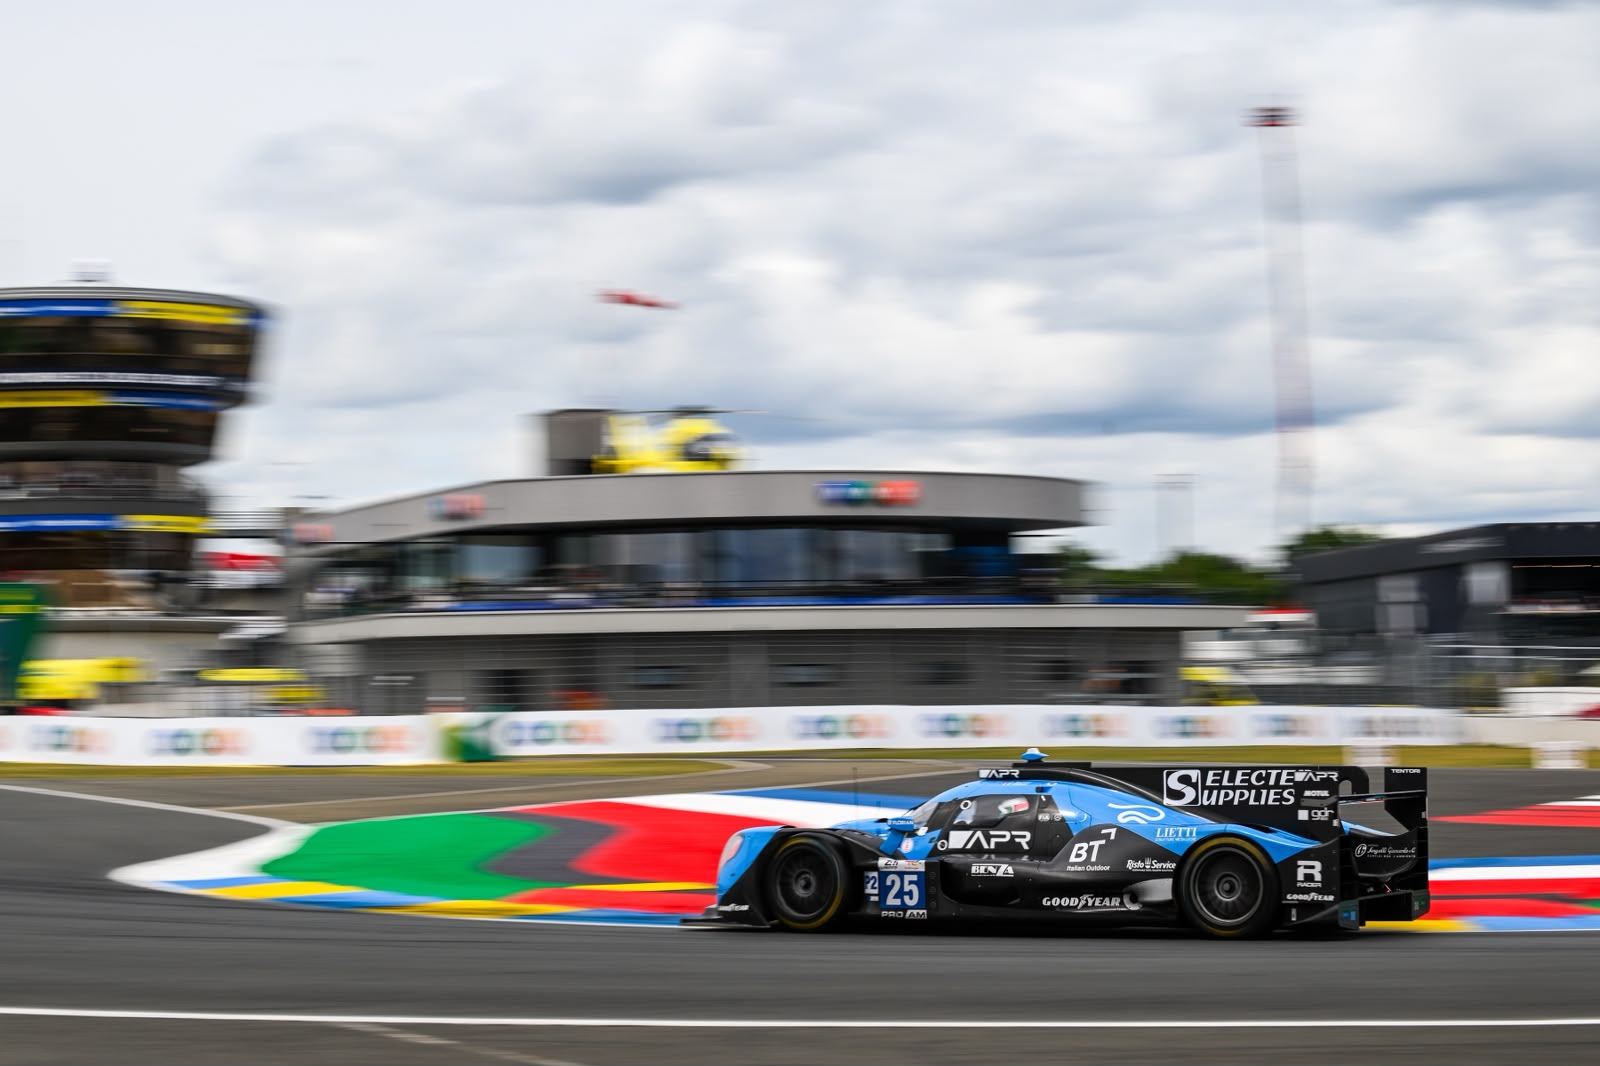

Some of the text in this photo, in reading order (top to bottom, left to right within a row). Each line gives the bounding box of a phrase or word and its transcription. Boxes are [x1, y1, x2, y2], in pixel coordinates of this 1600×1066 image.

[988, 769, 1020, 778] APR
[1303, 771, 1339, 781] APR
[1155, 826, 1197, 838] LIETTI
[965, 830, 1032, 850] APR
[1069, 840, 1106, 863] BT
[1066, 864, 1111, 872] Italian Outdoor
[1126, 859, 1176, 870] Risto Service
[885, 873, 919, 907] 25
[1041, 893, 1121, 910] GOODYEAR
[1286, 891, 1335, 902] GOODYEAR
[907, 911, 927, 919] AM
